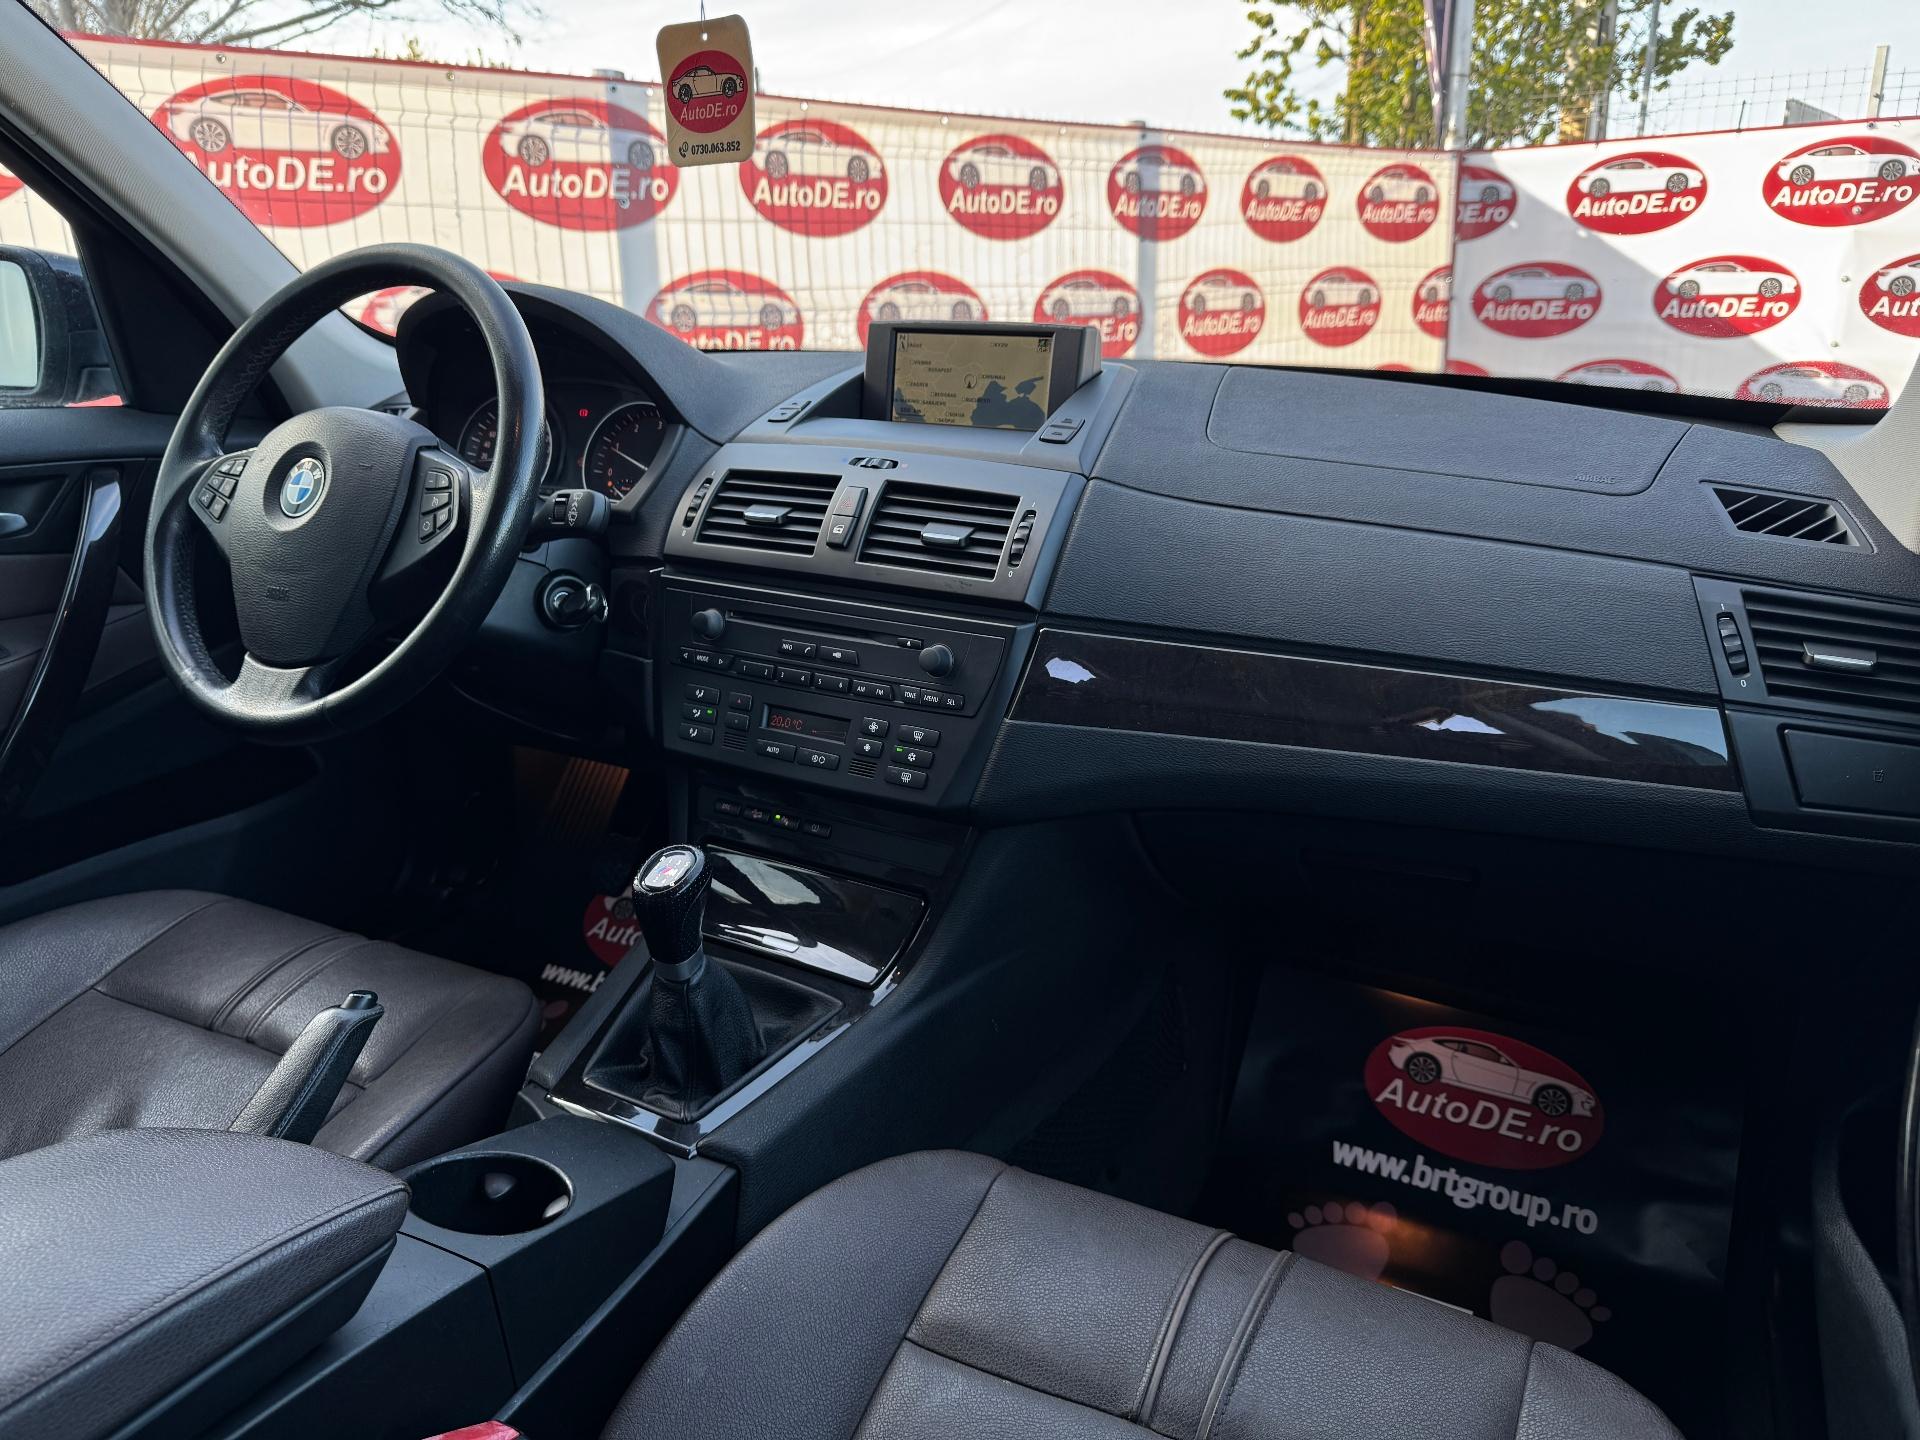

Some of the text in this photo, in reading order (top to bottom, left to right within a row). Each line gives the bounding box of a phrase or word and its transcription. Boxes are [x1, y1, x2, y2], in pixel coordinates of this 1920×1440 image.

[680, 102, 738, 121] AutoDE.ro
[691, 141, 741, 155] 0730.063.852
[502, 164, 670, 202] AutoDE.ro
[753, 176, 881, 211] AutoDE.ro
[1770, 181, 1914, 208] AutoDE.ro
[949, 187, 1058, 216] AutoDE.ro
[1113, 193, 1202, 220] AutoDE.ro
[1245, 199, 1322, 223] AutoDE.ro
[1361, 203, 1436, 224] AutoDE.ro
[1572, 192, 1697, 219] AutoDE.ro
[1301, 305, 1377, 329] AutoDE.ro
[1478, 300, 1595, 321] AutoDE.ro
[1660, 296, 1791, 319] AutoDE.ro
[1182, 312, 1263, 338] AutoDE.ro
[290, 461, 322, 480] BMW
[875, 688, 884, 696] FM
[904, 691, 917, 699] TONE
[923, 694, 939, 703] MENU
[946, 698, 956, 706] SEL
[1376, 1077, 1583, 1152] AutoDE.ro
[1332, 1140, 1599, 1235] www.brtgroup.ro
